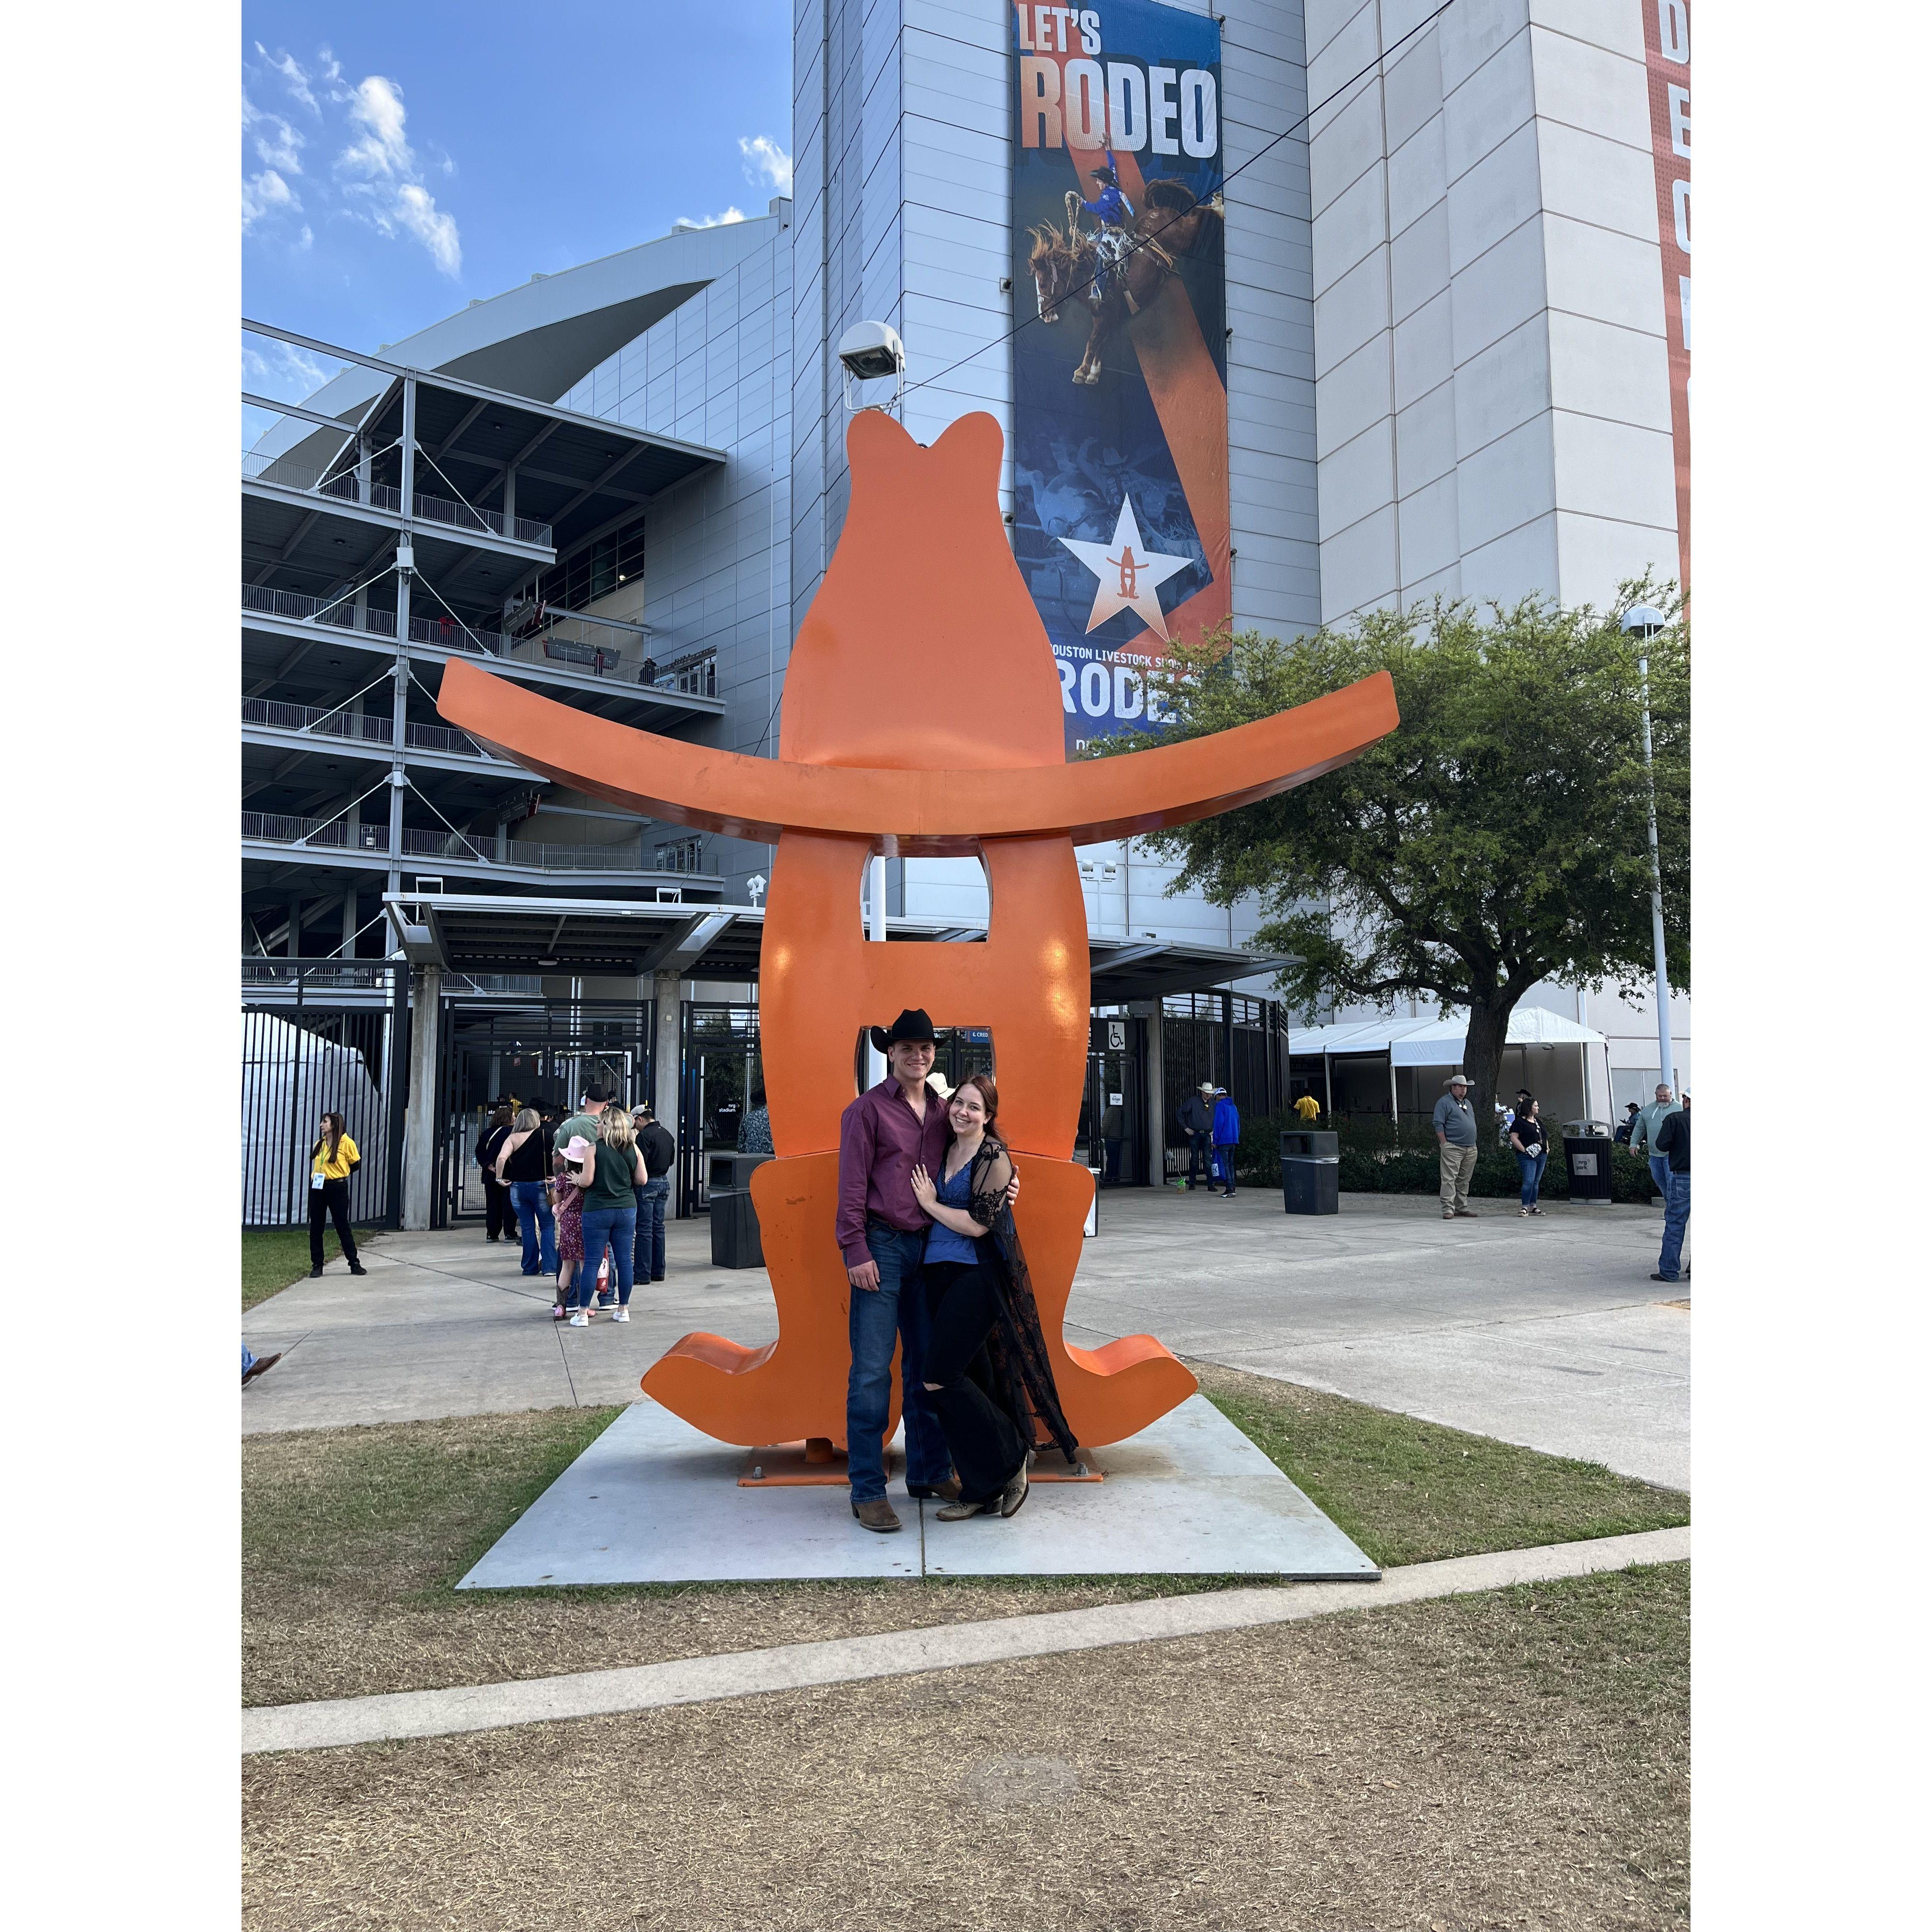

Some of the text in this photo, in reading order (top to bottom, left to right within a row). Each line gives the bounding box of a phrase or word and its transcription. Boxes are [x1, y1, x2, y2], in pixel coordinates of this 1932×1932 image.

[1018, 3, 1102, 55] LET'S
[1020, 56, 1217, 158] RODEO
[1050, 644, 1092, 660] OUSTON
[1095, 649, 1152, 667] LIVESTOCK
